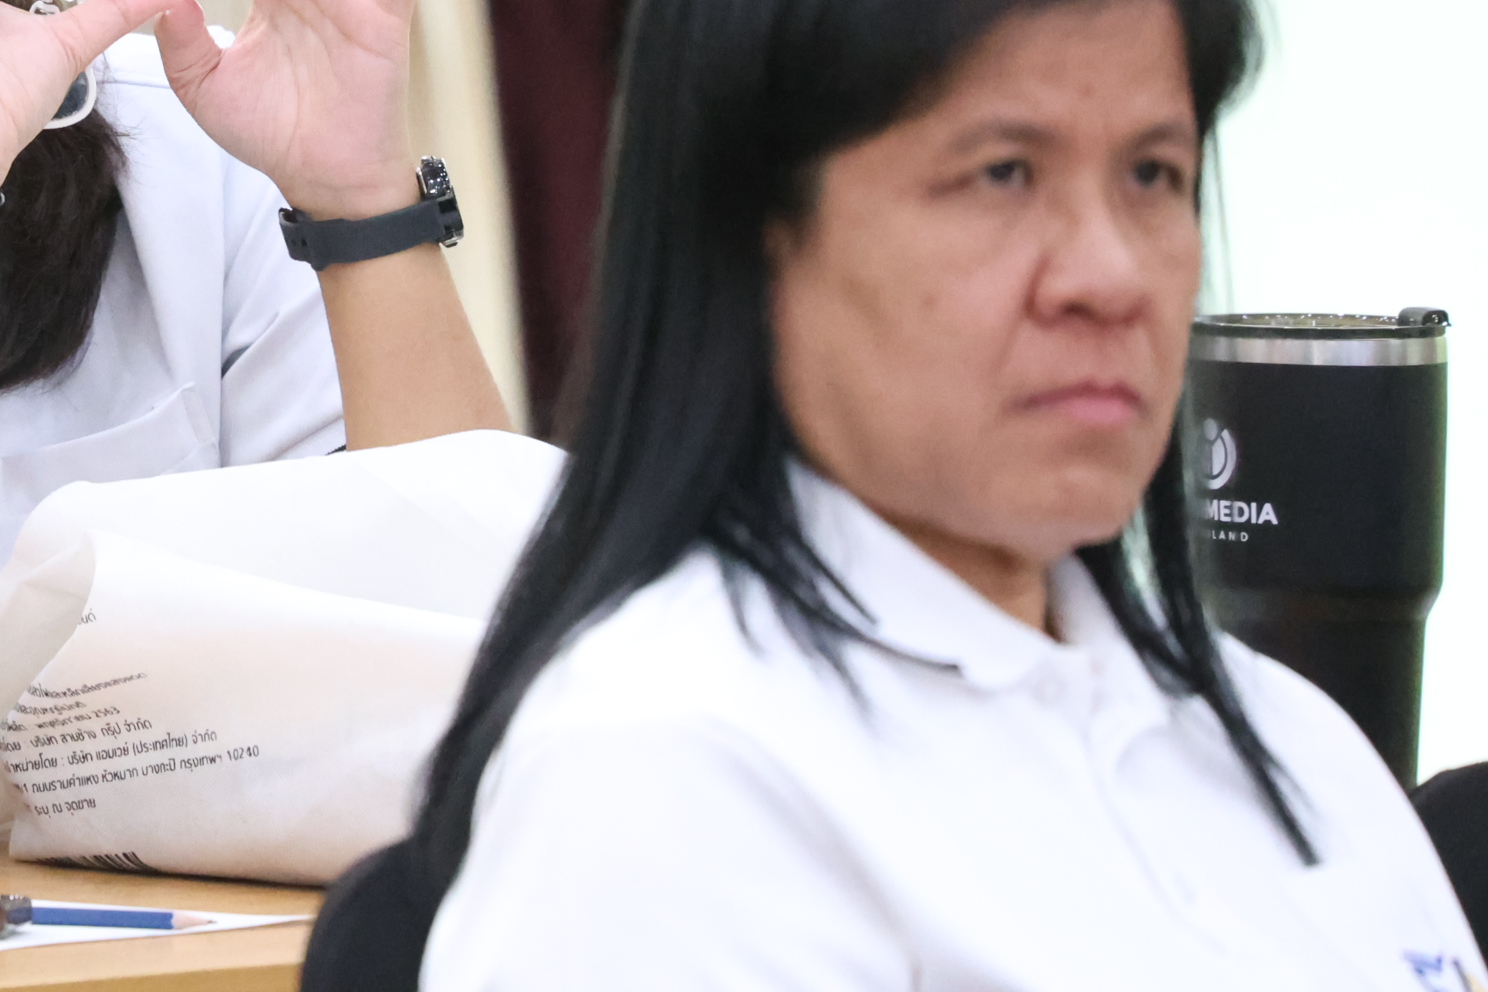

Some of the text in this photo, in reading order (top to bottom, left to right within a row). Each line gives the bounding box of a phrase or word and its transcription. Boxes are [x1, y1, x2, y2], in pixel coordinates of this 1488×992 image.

[1202, 499, 1279, 525] MEDIA
[124, 717, 153, 733] จำกัด
[67, 750, 93, 765] บริษัท
[95, 742, 130, 761] แอมเวย์
[191, 729, 218, 745] จำกัด
[226, 744, 260, 762] 10240
